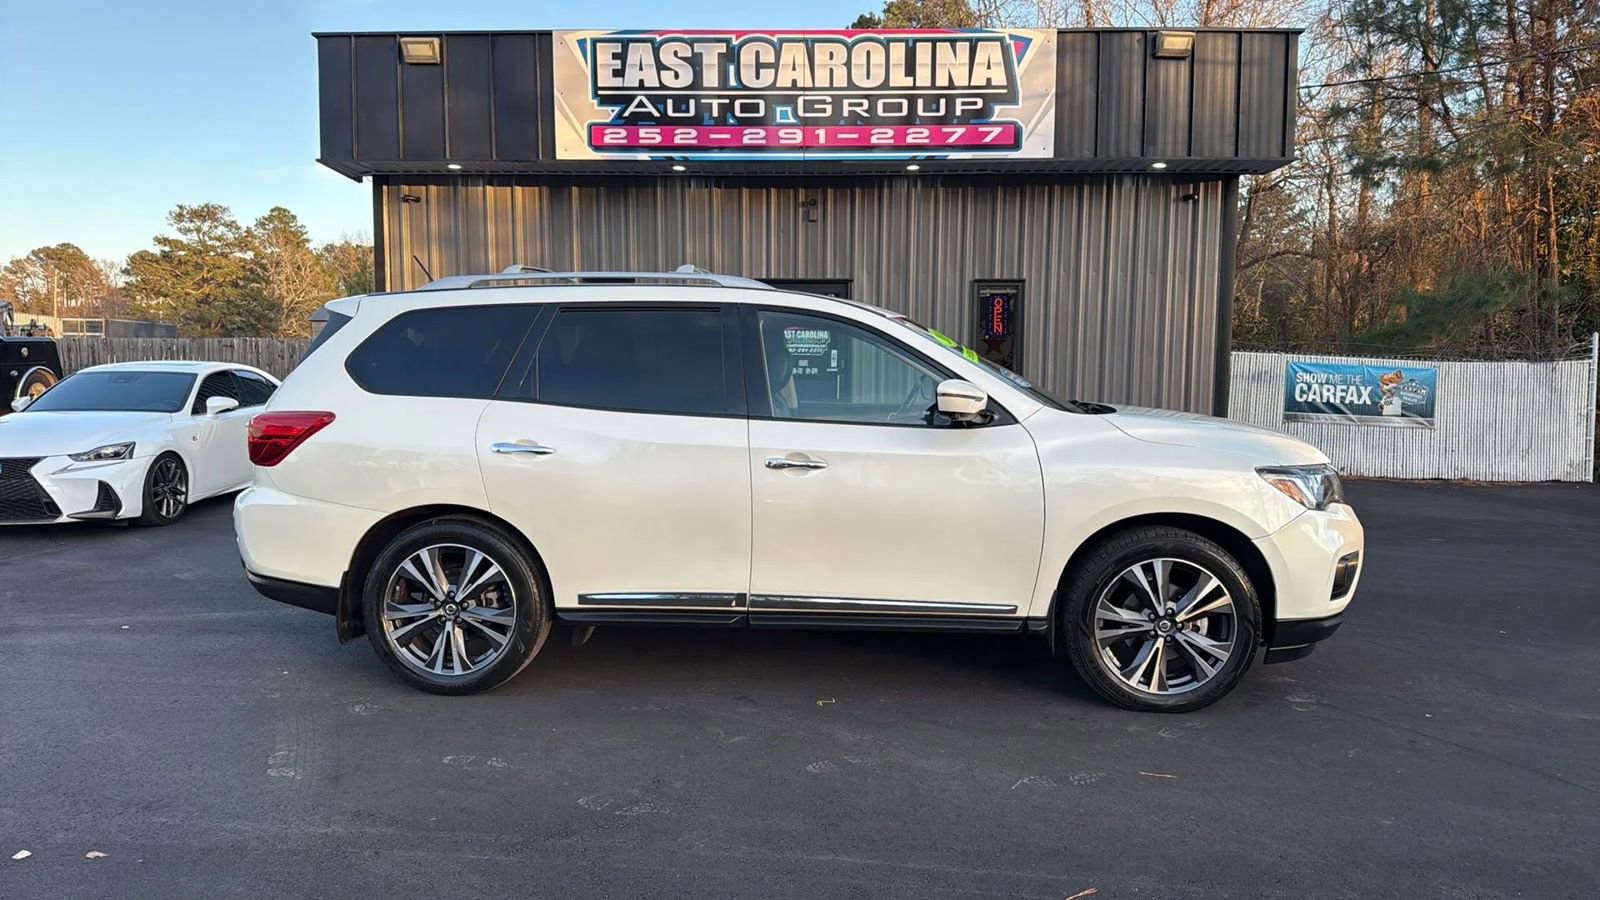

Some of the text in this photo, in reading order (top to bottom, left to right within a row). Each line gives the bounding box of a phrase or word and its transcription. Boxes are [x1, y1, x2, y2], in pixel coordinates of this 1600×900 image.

[596, 42, 1007, 88] EAST CAROLINA
[623, 95, 983, 117] AUTO GROUP
[603, 128, 1003, 144] 252-291-2277
[994, 298, 1003, 334] OPEN
[796, 330, 828, 339] CAROLINA
[1296, 372, 1363, 386] SHOW ME THE
[1295, 383, 1372, 405] CARFAX
